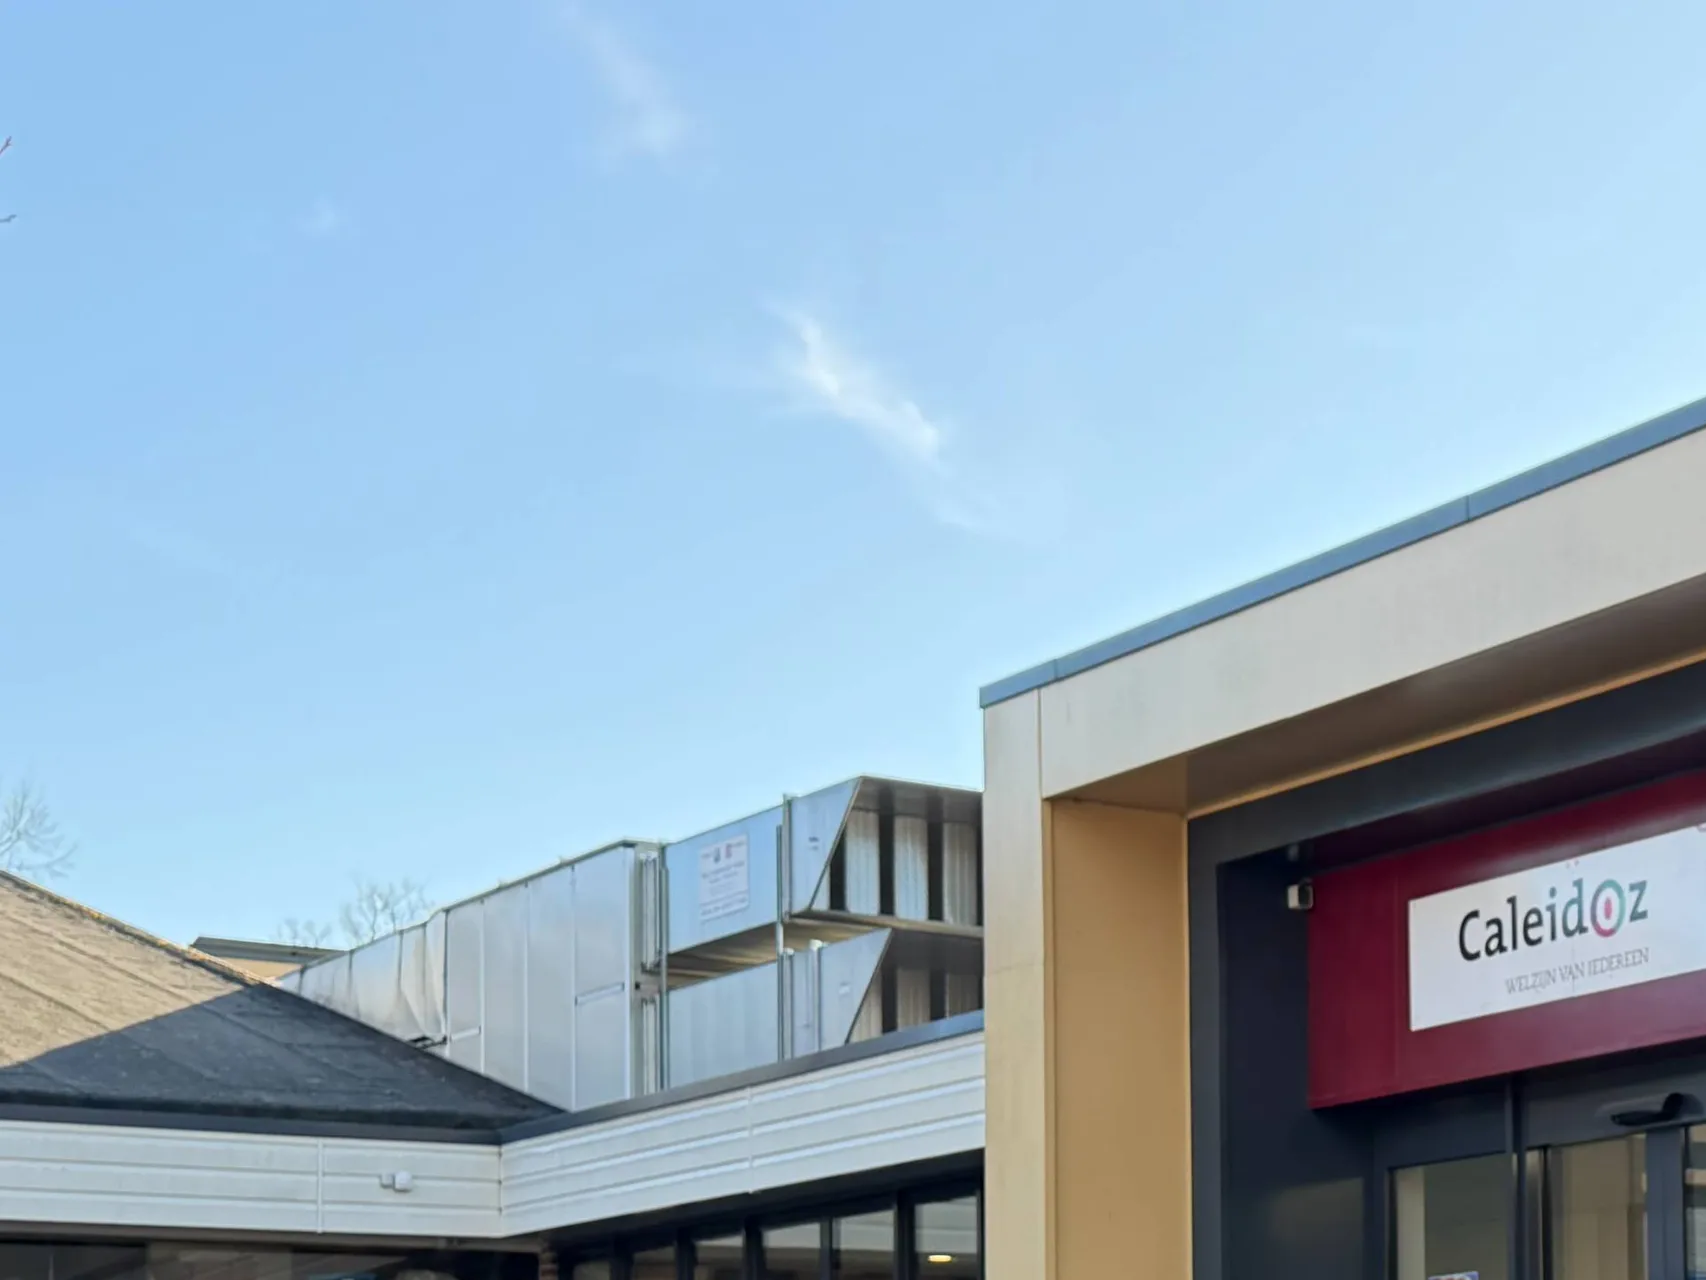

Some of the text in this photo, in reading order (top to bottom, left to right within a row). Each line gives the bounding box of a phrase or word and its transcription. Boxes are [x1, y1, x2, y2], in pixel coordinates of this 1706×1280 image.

[1505, 947, 1649, 994] WELZIJN VAN IEDEREEN
